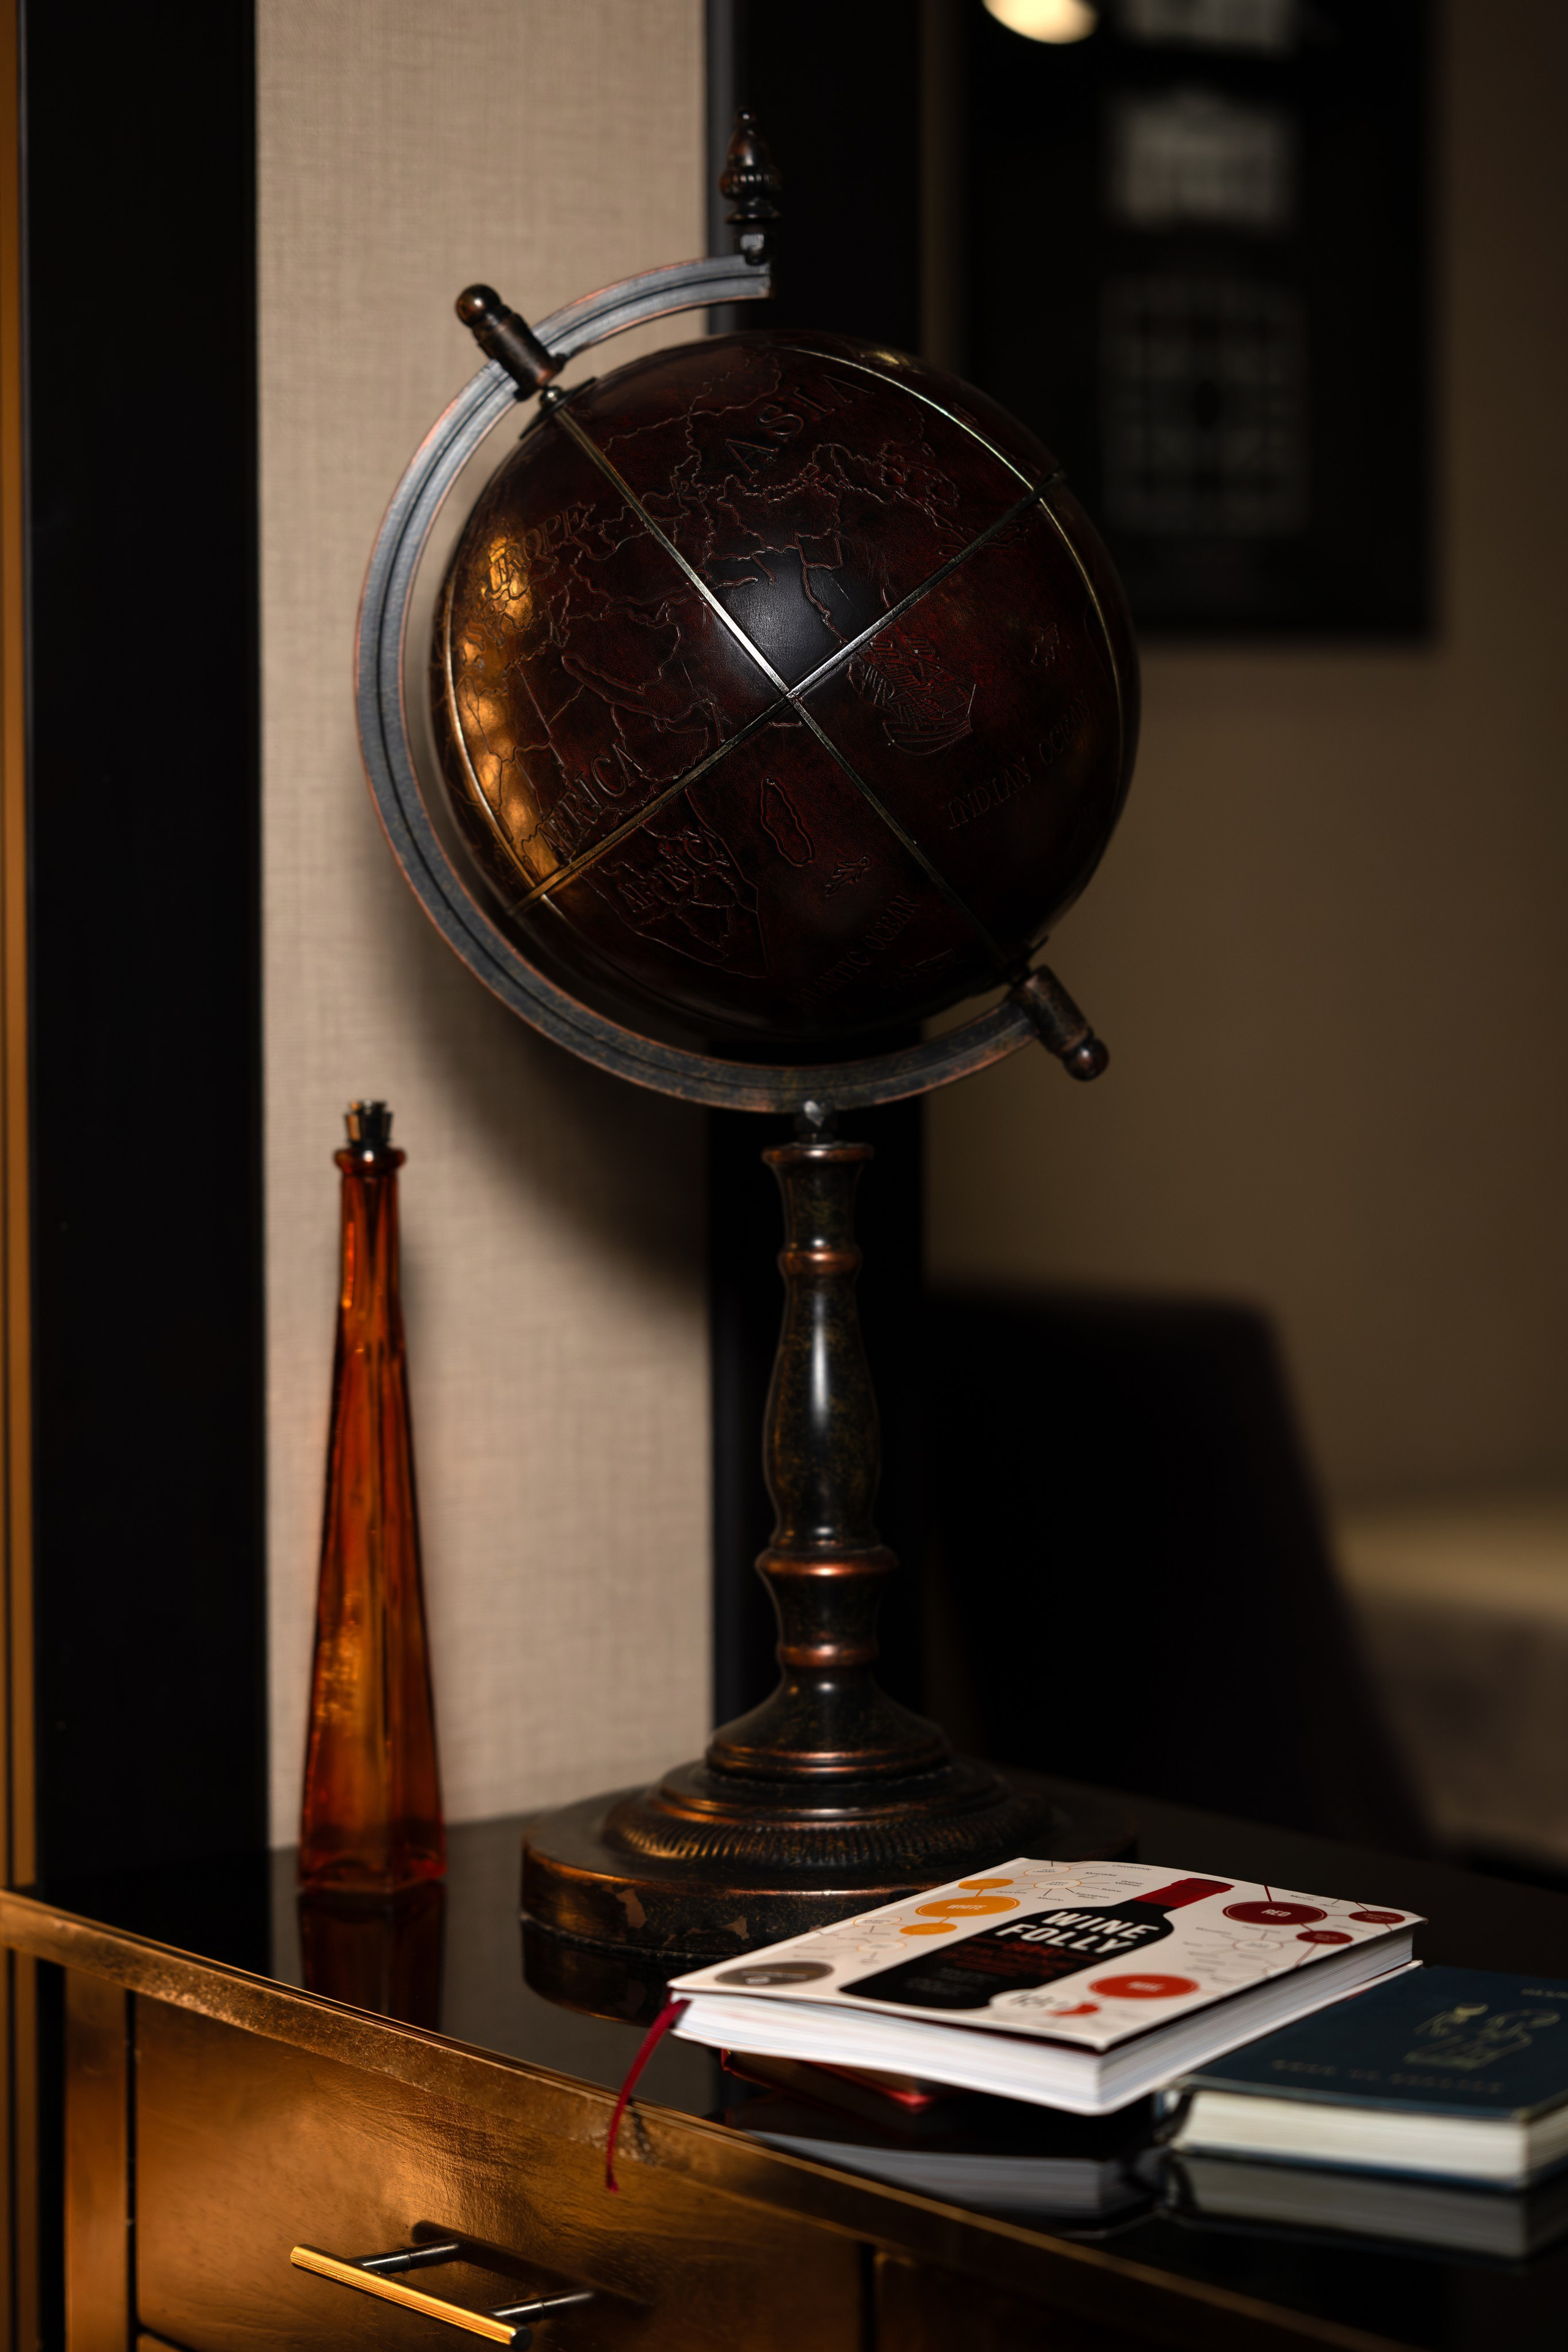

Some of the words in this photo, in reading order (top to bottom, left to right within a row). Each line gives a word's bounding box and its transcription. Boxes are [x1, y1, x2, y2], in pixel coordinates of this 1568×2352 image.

[725, 374, 876, 480] ASIA
[940, 756, 1032, 831] INDIAN
[862, 894, 919, 950] OCEAN
[1041, 1910, 1161, 1940] WINE
[1261, 1909, 1292, 1918] RED
[994, 1922, 1136, 1954] FOLLY
